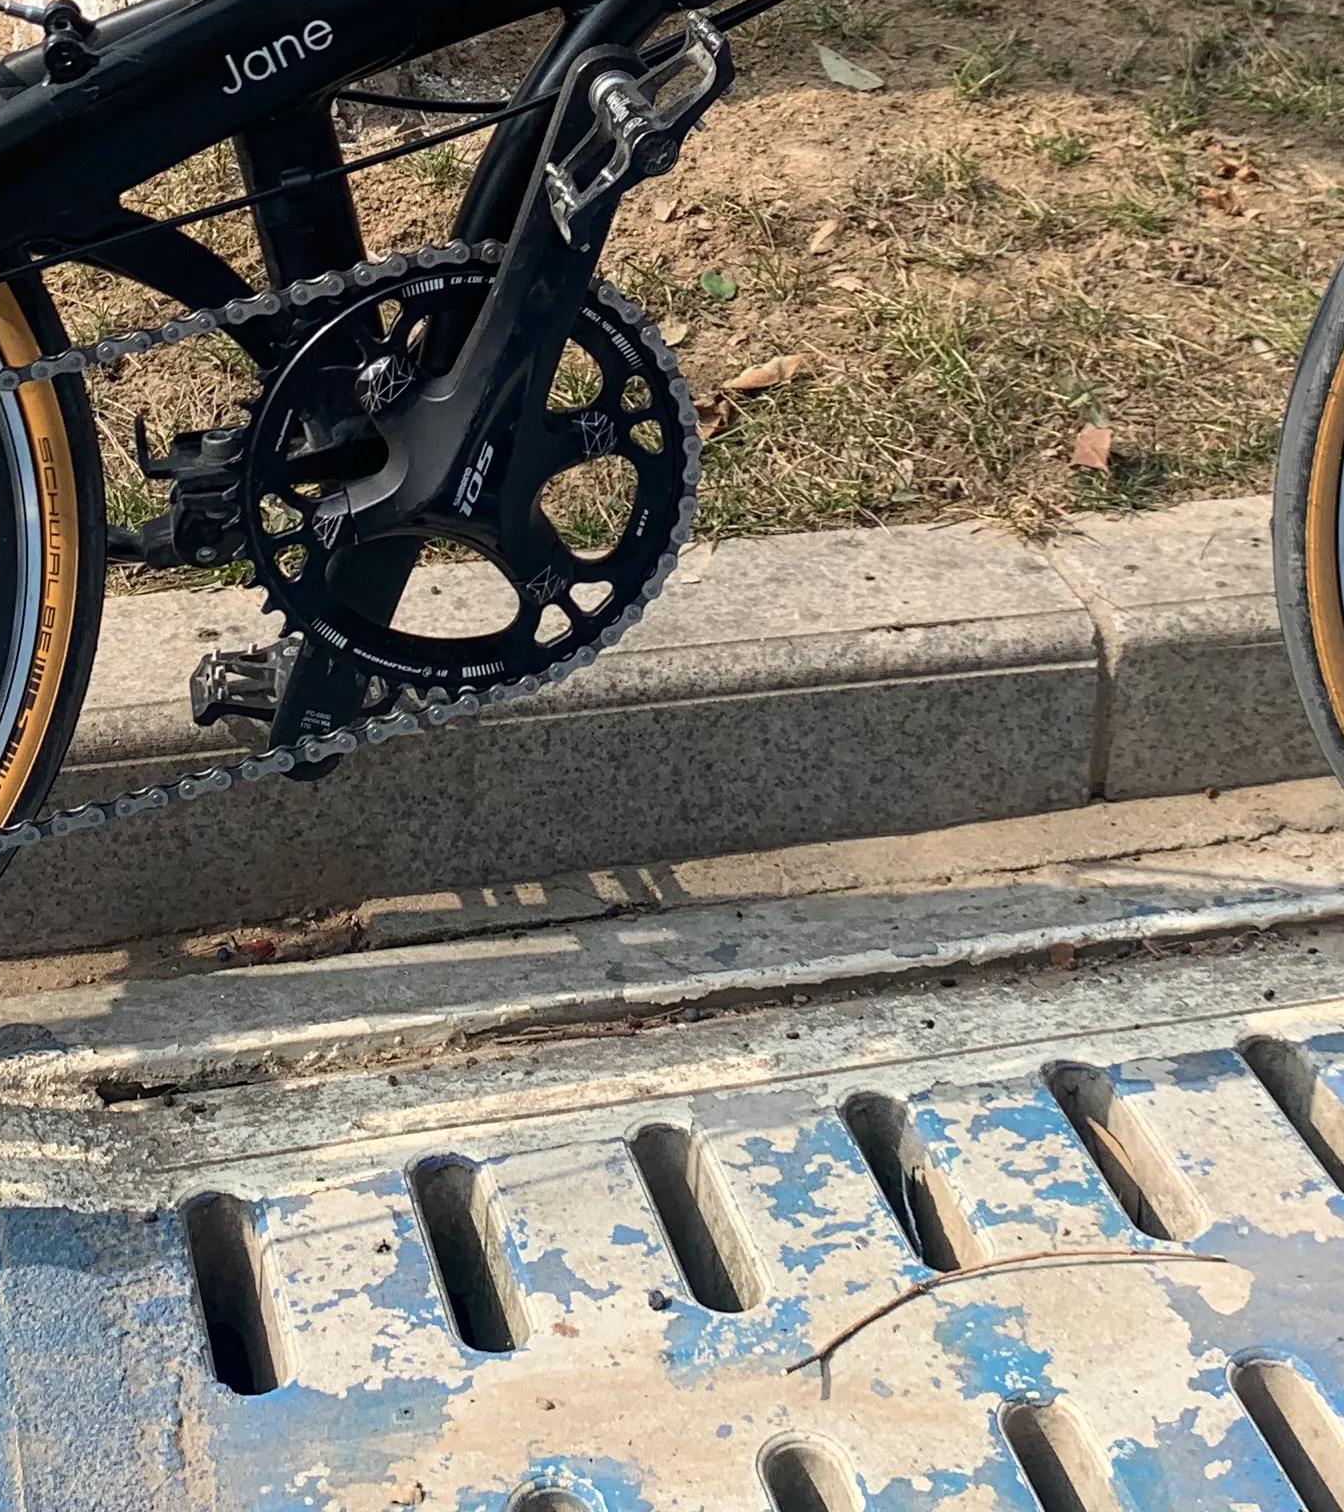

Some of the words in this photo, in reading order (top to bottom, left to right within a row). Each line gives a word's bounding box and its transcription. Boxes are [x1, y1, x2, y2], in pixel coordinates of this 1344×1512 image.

[222, 19, 334, 94] Jane
[459, 441, 494, 517] 105
[37, 437, 61, 654] SCHWALBE
